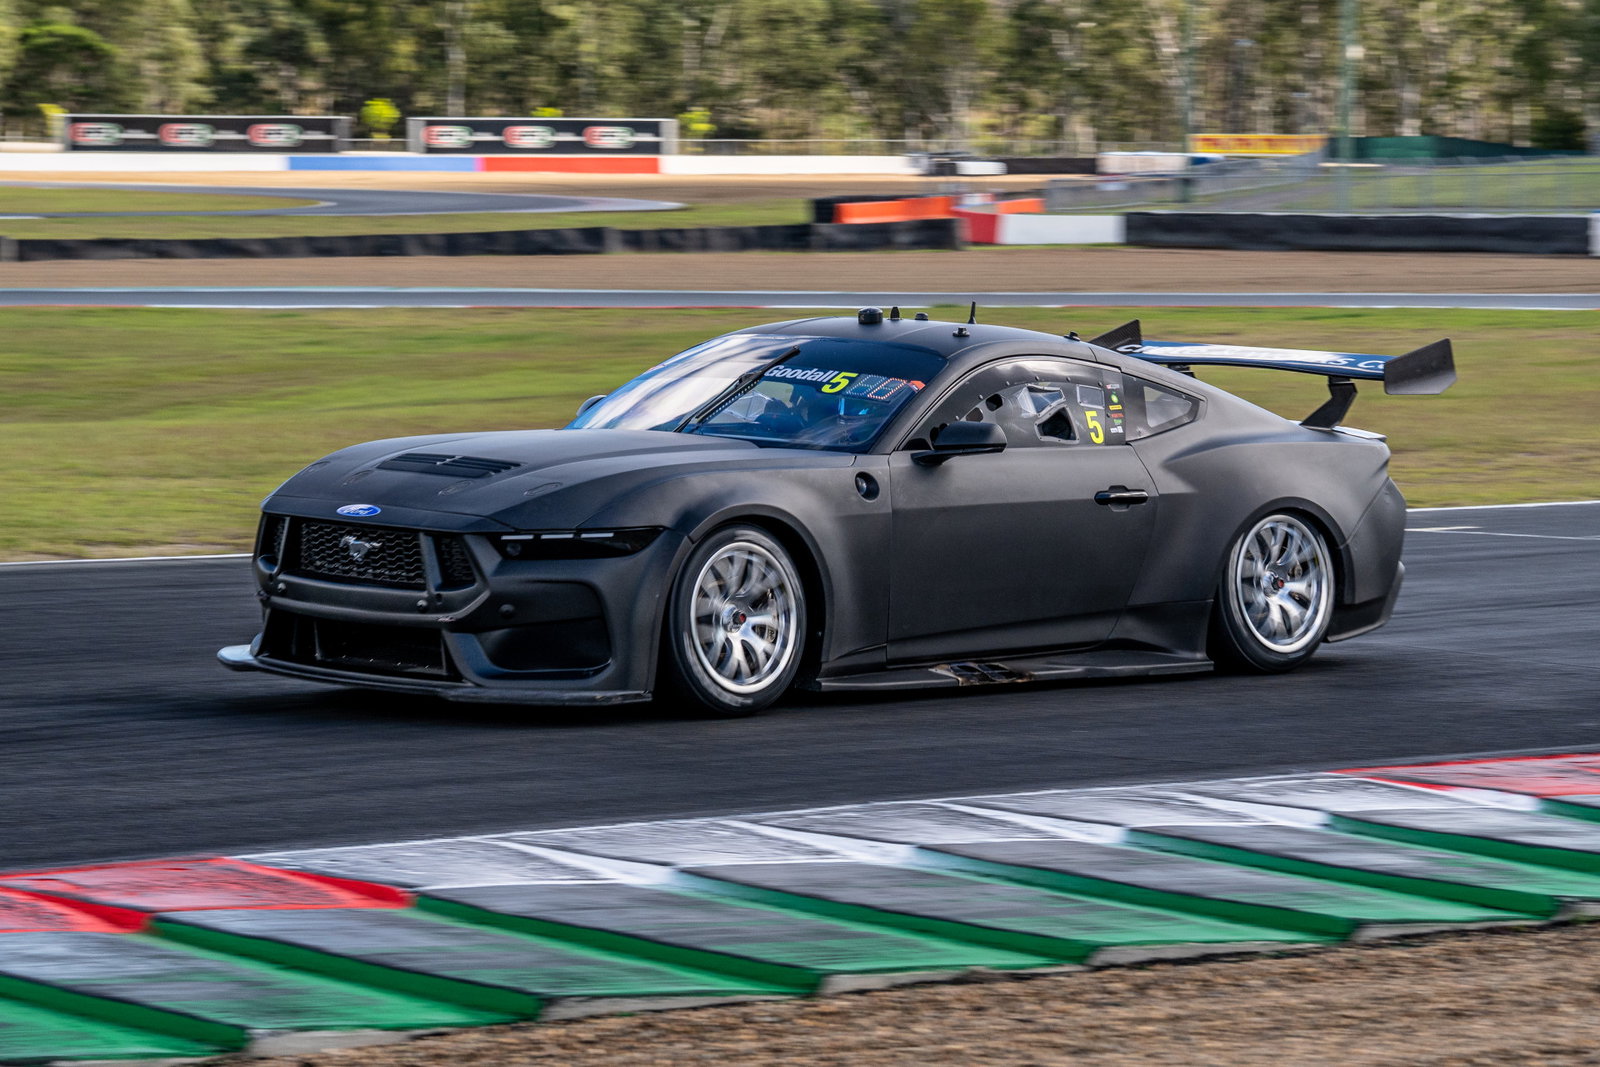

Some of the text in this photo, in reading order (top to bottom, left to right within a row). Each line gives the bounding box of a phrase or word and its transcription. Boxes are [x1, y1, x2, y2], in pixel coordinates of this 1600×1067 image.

[764, 365, 859, 394] Goodall 5
[1085, 410, 1104, 444] 5
